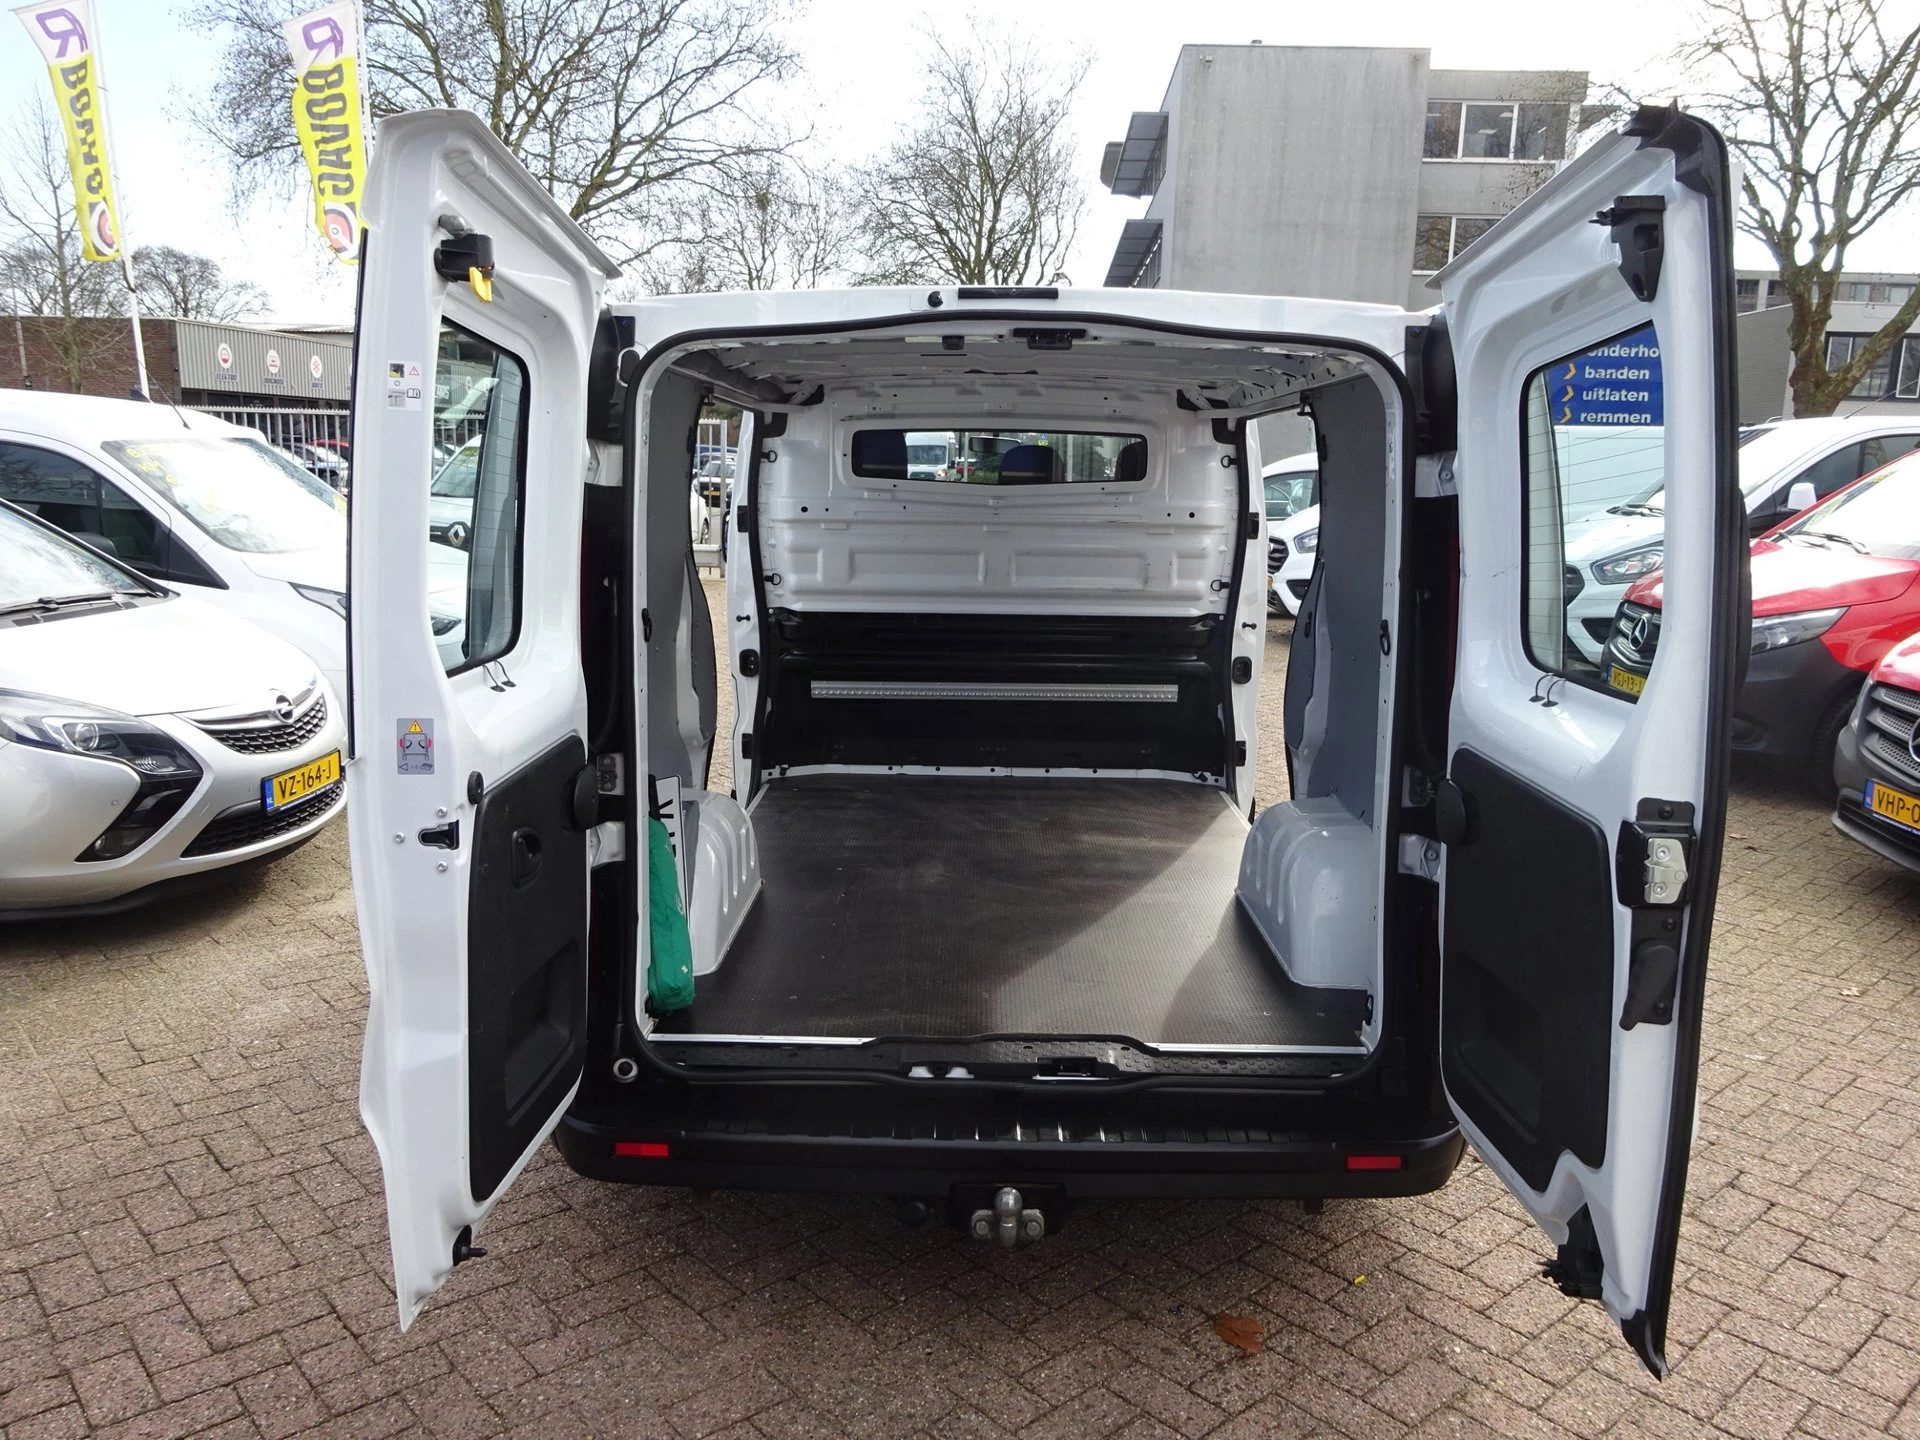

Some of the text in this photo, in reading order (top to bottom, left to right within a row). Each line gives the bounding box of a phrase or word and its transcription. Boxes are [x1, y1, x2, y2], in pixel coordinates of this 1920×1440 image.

[1584, 366, 1650, 380] banden
[1582, 388, 1649, 402] uitlaten
[1580, 412, 1651, 424] remmen
[278, 759, 332, 800] VZ-164-J
